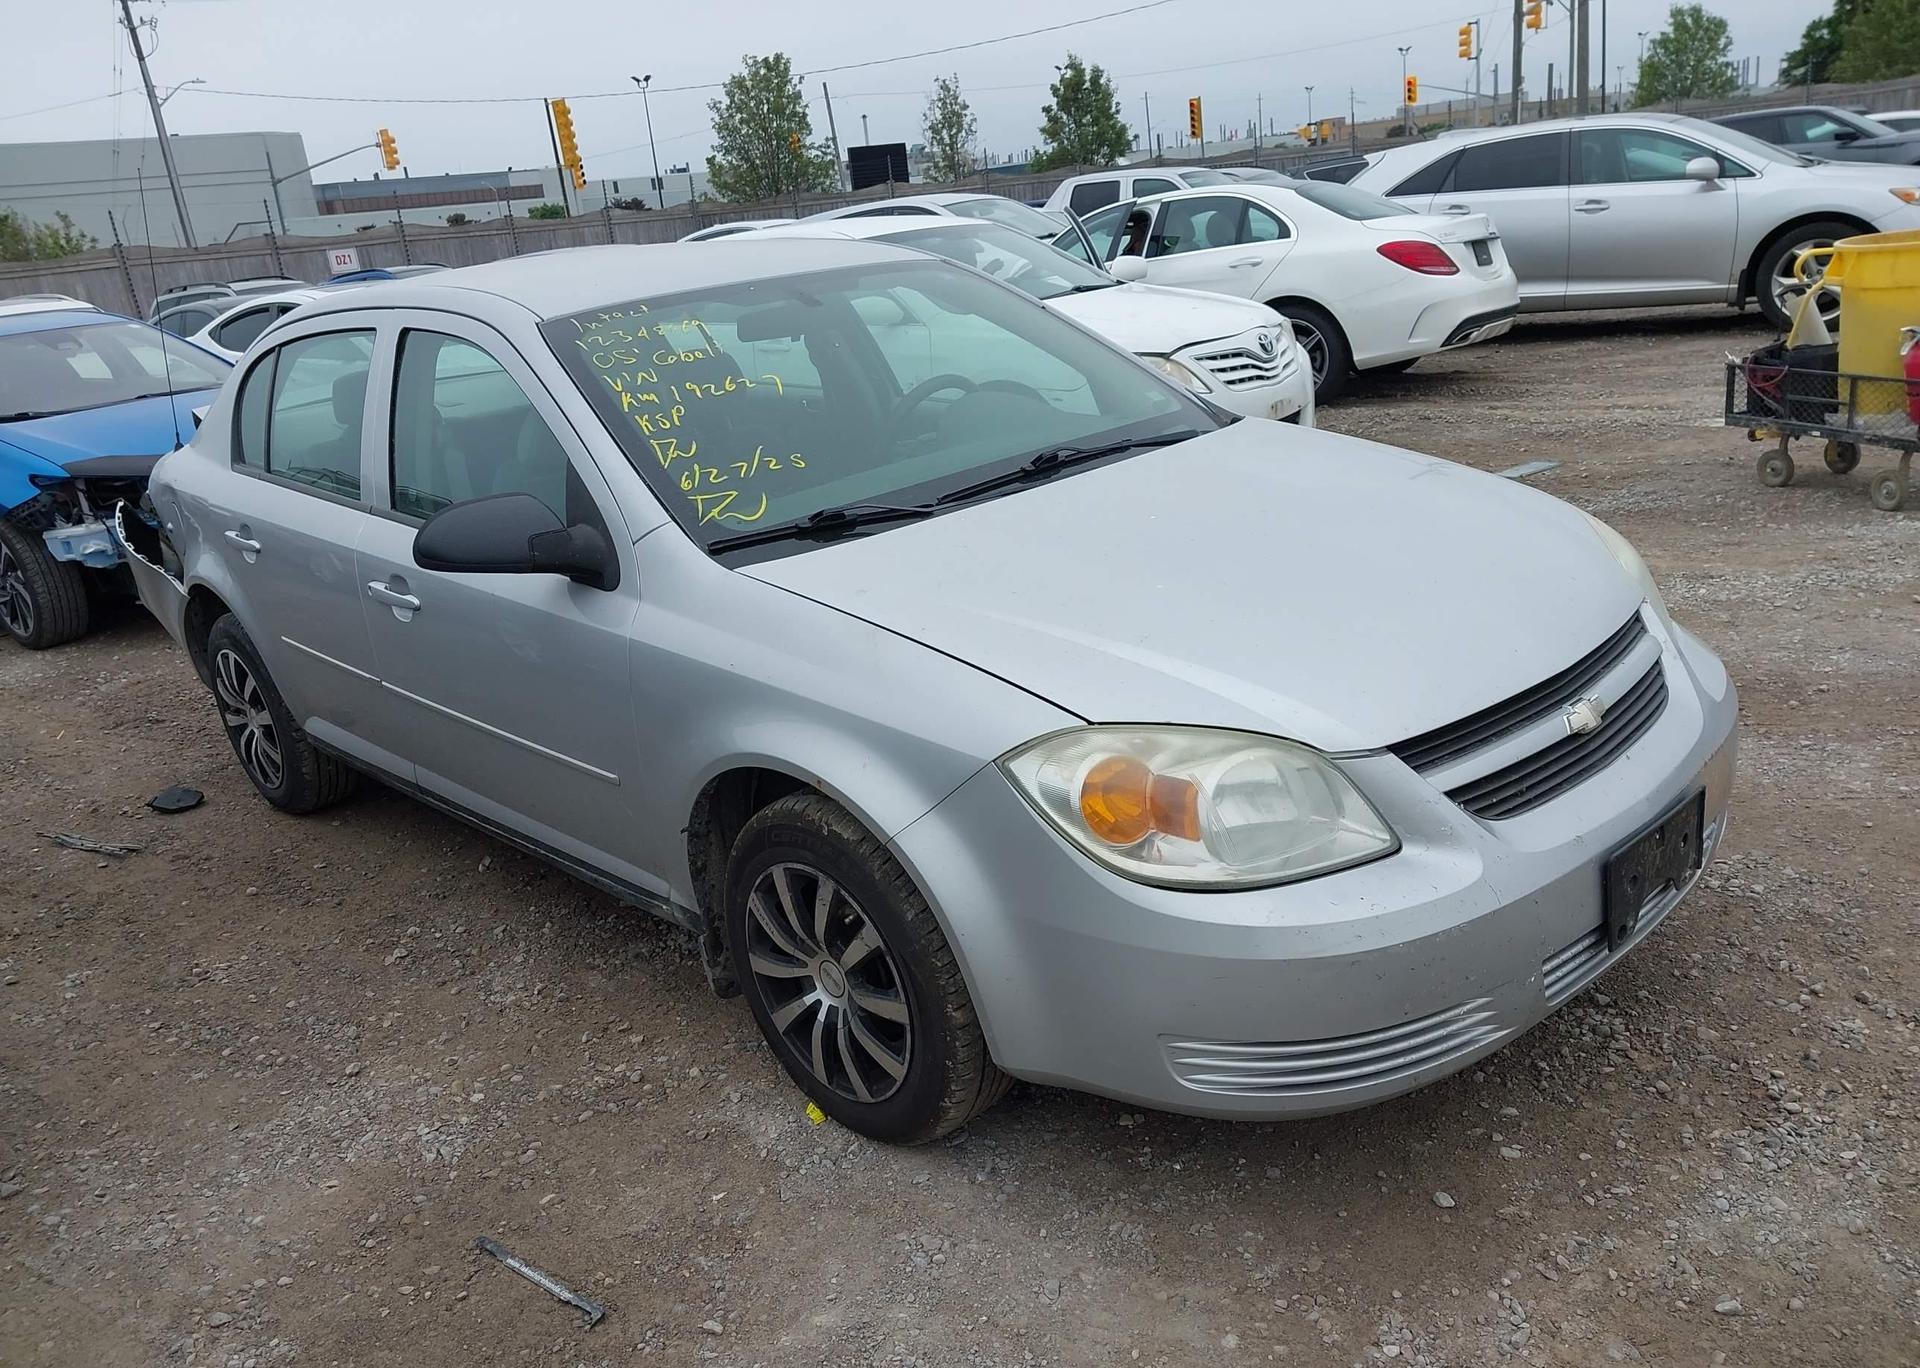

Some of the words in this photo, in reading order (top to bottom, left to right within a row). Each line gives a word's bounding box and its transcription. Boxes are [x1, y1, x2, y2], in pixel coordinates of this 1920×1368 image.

[335, 253, 353, 266] DZ1
[670, 374, 784, 402] 192627
[680, 445, 806, 491] 6/27/25
